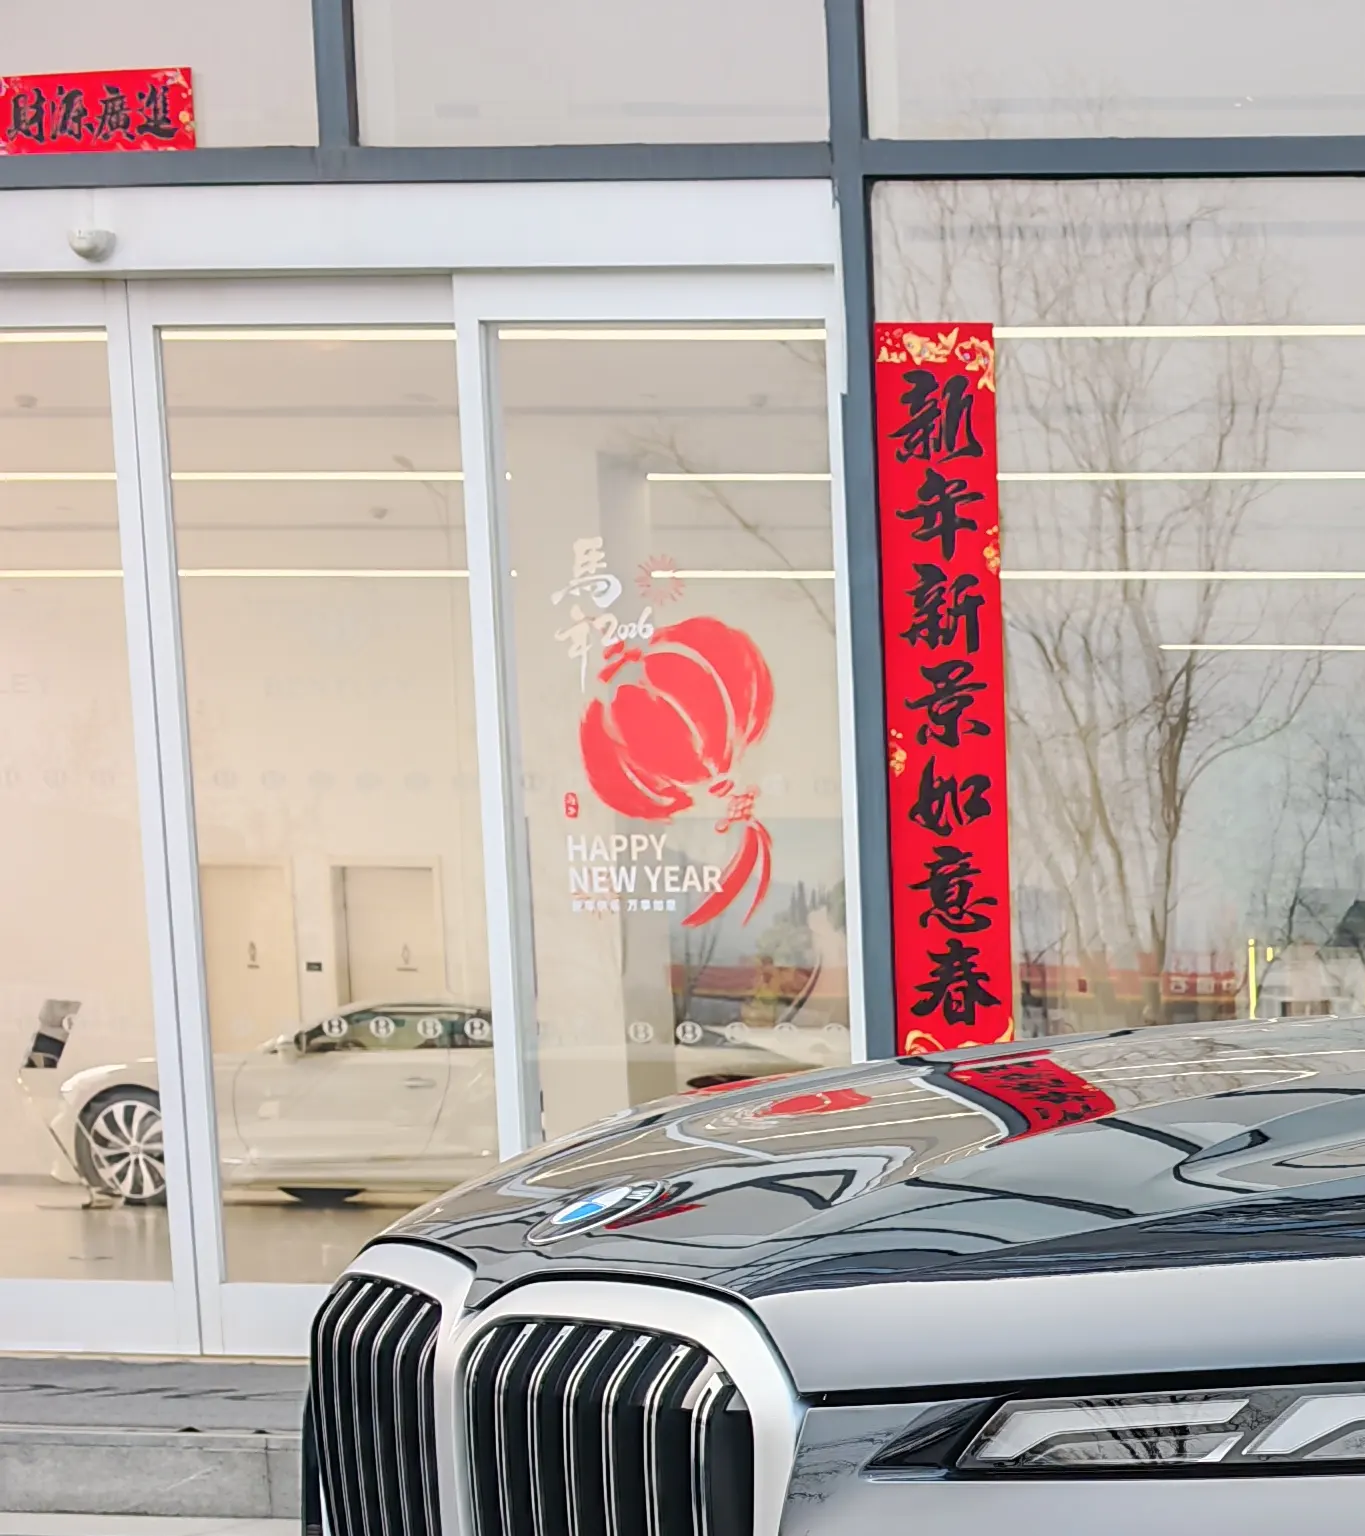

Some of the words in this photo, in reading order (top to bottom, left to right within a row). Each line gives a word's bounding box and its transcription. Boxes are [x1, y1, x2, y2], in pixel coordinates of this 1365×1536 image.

[593, 606, 654, 646] 2026
[889, 369, 1001, 1026] 新年新景如意春
[567, 834, 667, 862] HAPPY
[568, 866, 637, 893] NEW
[644, 865, 724, 893] YEAR
